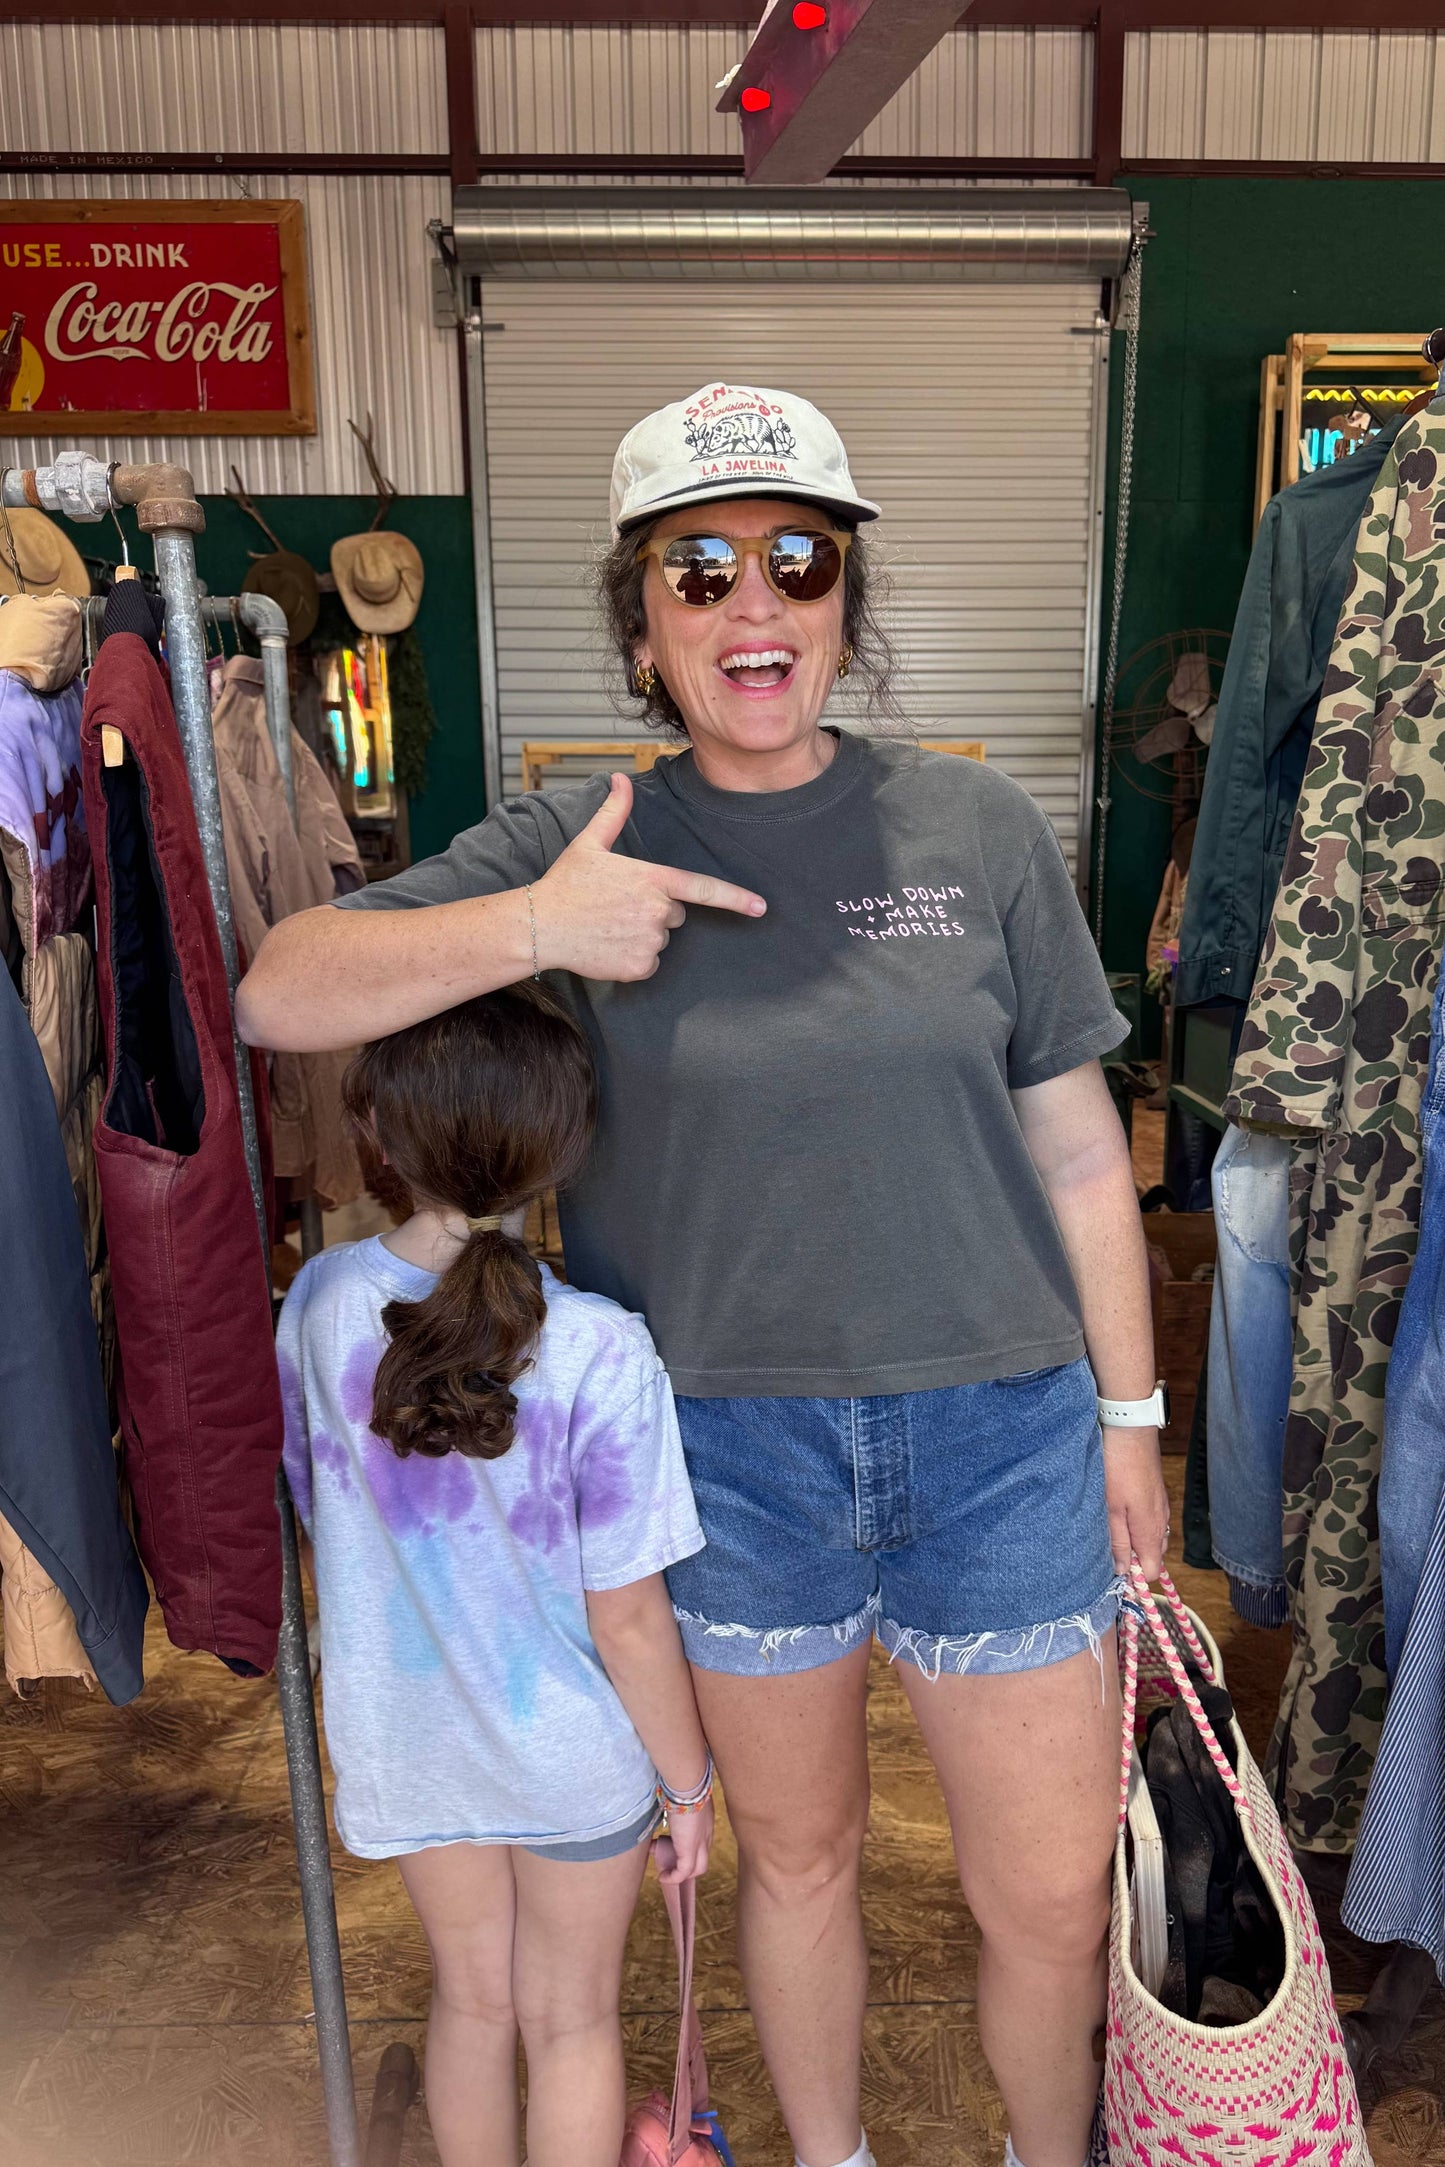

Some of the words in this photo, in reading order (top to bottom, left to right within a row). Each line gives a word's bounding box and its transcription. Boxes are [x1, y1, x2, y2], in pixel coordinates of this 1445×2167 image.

[20, 155, 58, 164] MADE
[69, 156, 86, 164] IN
[96, 156, 154, 165] MEXICO
[44, 281, 278, 363] Coca-Cola
[702, 401, 756, 421] Provisions
[702, 463, 719, 476] LA
[725, 460, 787, 473] JAVELINA
[836, 893, 894, 913] SLOW
[902, 886, 965, 902] DOWN
[885, 904, 948, 922] MAKE
[847, 921, 965, 941] MEMORIES
